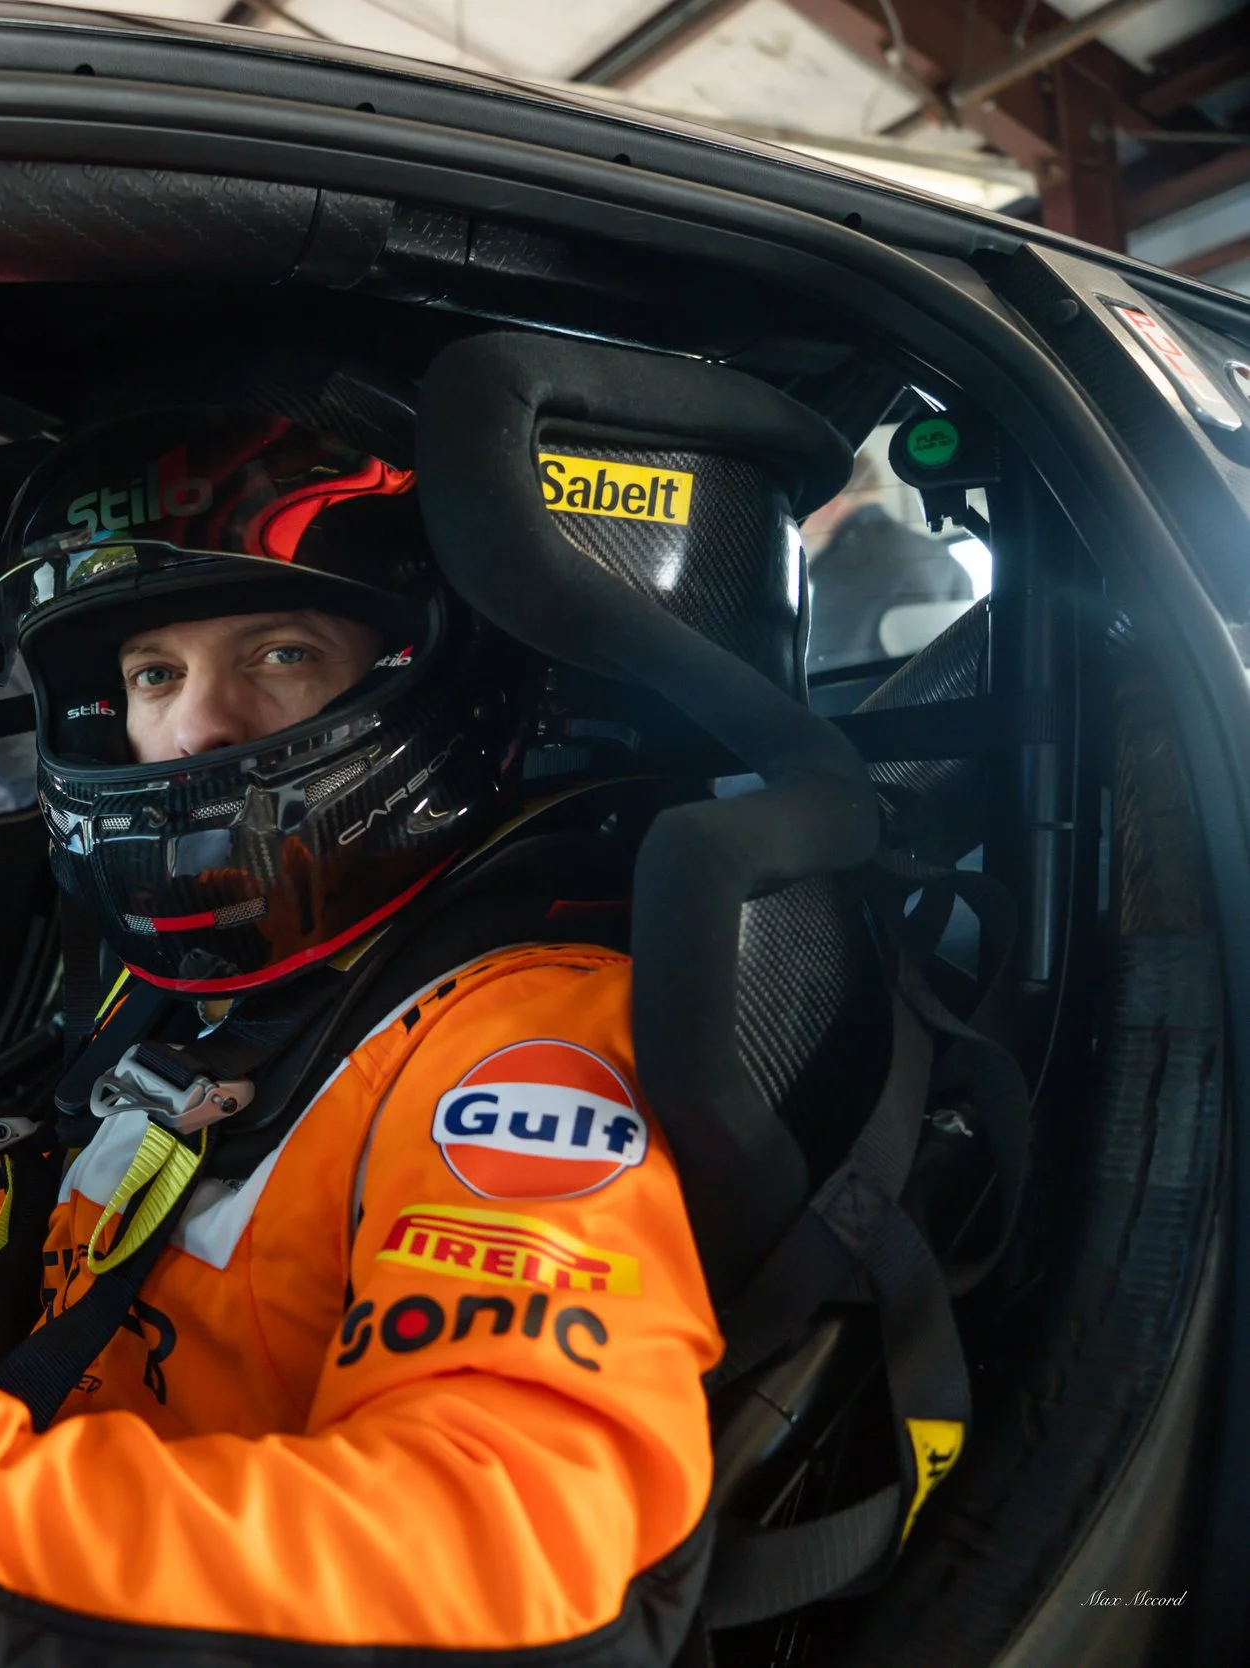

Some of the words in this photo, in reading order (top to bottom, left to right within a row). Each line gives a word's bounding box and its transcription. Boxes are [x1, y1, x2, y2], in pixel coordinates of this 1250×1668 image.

[67, 442, 214, 534] stilo
[540, 459, 679, 520] Sabelt
[370, 645, 413, 670] stilo
[66, 699, 117, 720] stilo
[444, 1092, 639, 1154] Gulf
[382, 1213, 612, 1292] PIRELLI
